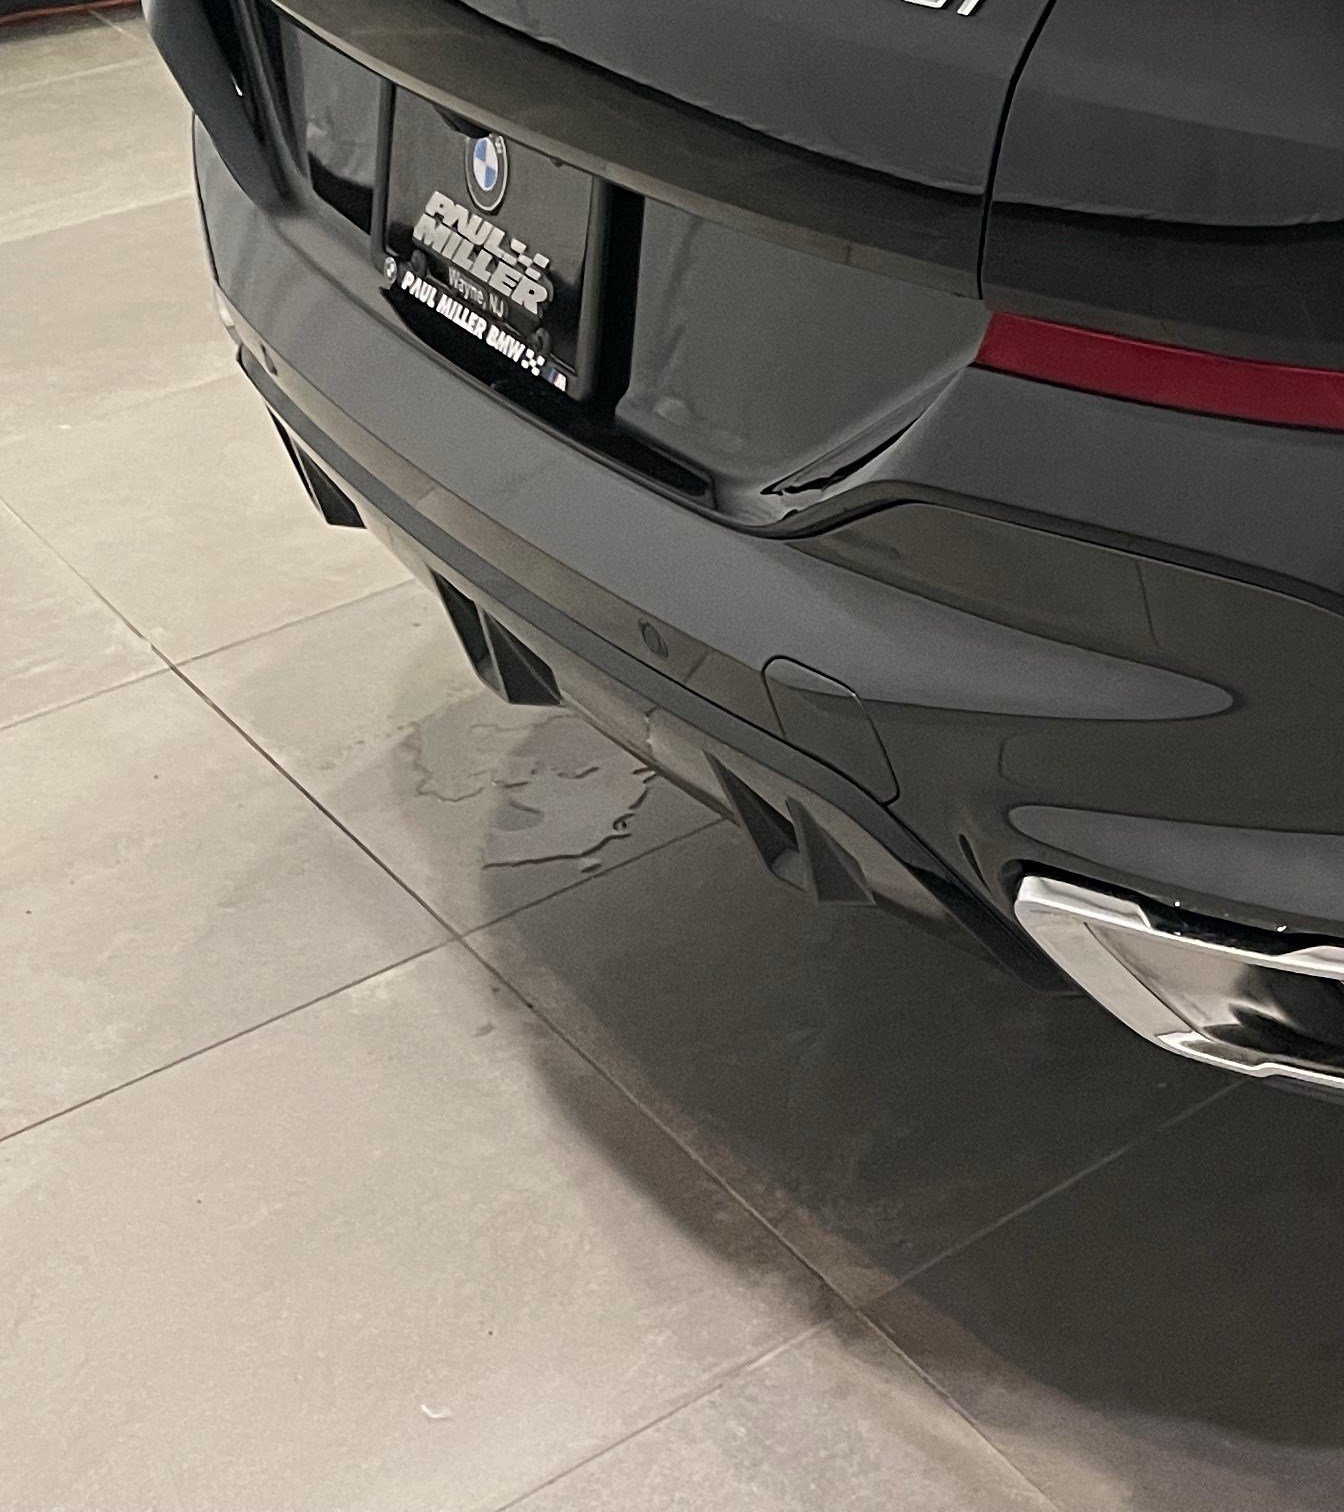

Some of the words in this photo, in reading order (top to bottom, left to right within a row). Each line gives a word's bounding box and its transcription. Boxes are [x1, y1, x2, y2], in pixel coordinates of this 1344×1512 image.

[412, 213, 548, 315] MILLER
[425, 191, 505, 258] PAUL
[401, 271, 437, 309] PAUL
[436, 294, 487, 340] MILLER
[486, 325, 526, 363] BMW
